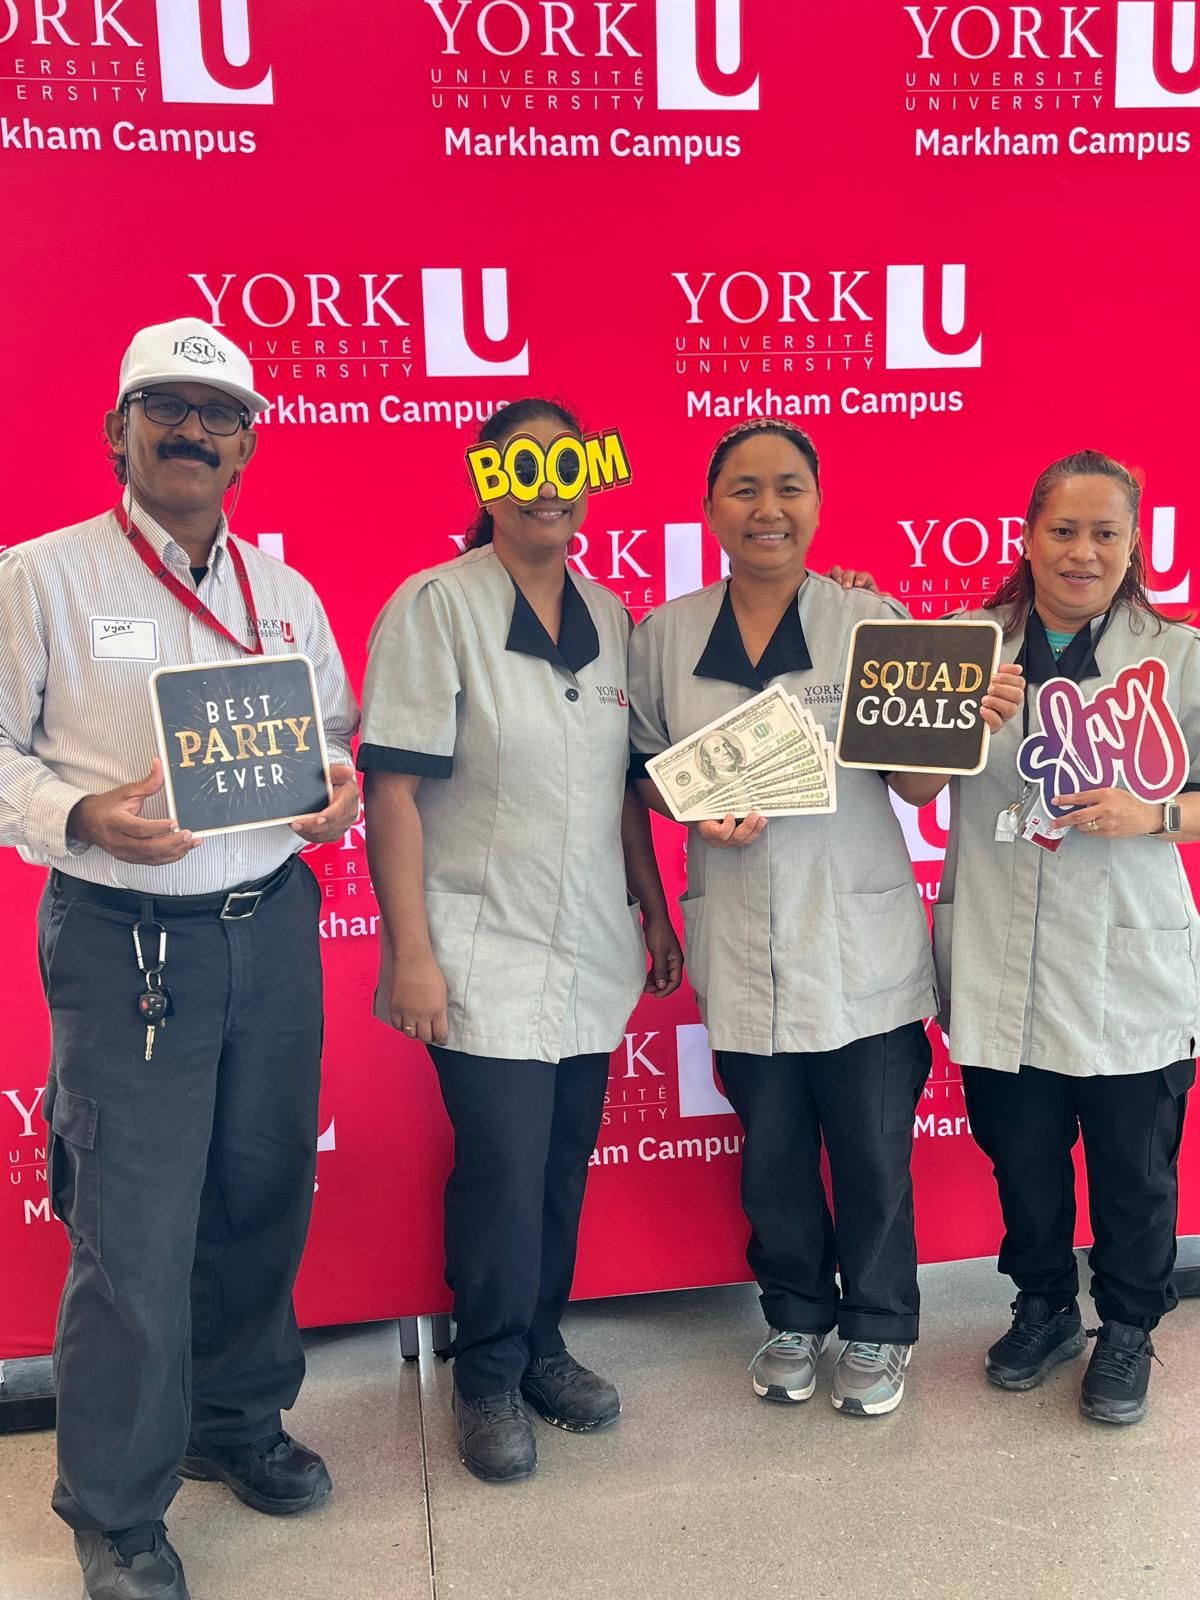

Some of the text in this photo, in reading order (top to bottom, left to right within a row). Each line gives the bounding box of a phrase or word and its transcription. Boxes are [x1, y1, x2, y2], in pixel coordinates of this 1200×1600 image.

[425, 0, 642, 57] YORK
[903, 6, 1103, 59] YORK
[431, 68, 643, 86] UNIVERSITÉ
[906, 69, 1102, 86] UNIVERSITÉ
[432, 94, 643, 110] UNIVERSITY
[906, 96, 1102, 110] UNIVERSITY
[112, 121, 256, 160] Campus
[445, 126, 741, 164] Markham Campus
[915, 126, 1191, 160] Markham Campus
[188, 273, 410, 327] YORK
[671, 270, 873, 324] YORK
[171, 340, 226, 363] JESUS
[675, 331, 873, 351] UNIVERSITÉ
[676, 356, 873, 374] UNIVERSITY
[687, 387, 963, 420] Markham Campus
[465, 428, 632, 506] BOOM
[804, 684, 842, 696] YORK
[860, 661, 983, 695] SQUAD
[206, 694, 270, 724] BEST
[856, 695, 978, 730] GOALS
[174, 716, 312, 768] PARTY
[215, 763, 284, 793] EVER
[638, 1135, 745, 1162] Campu
